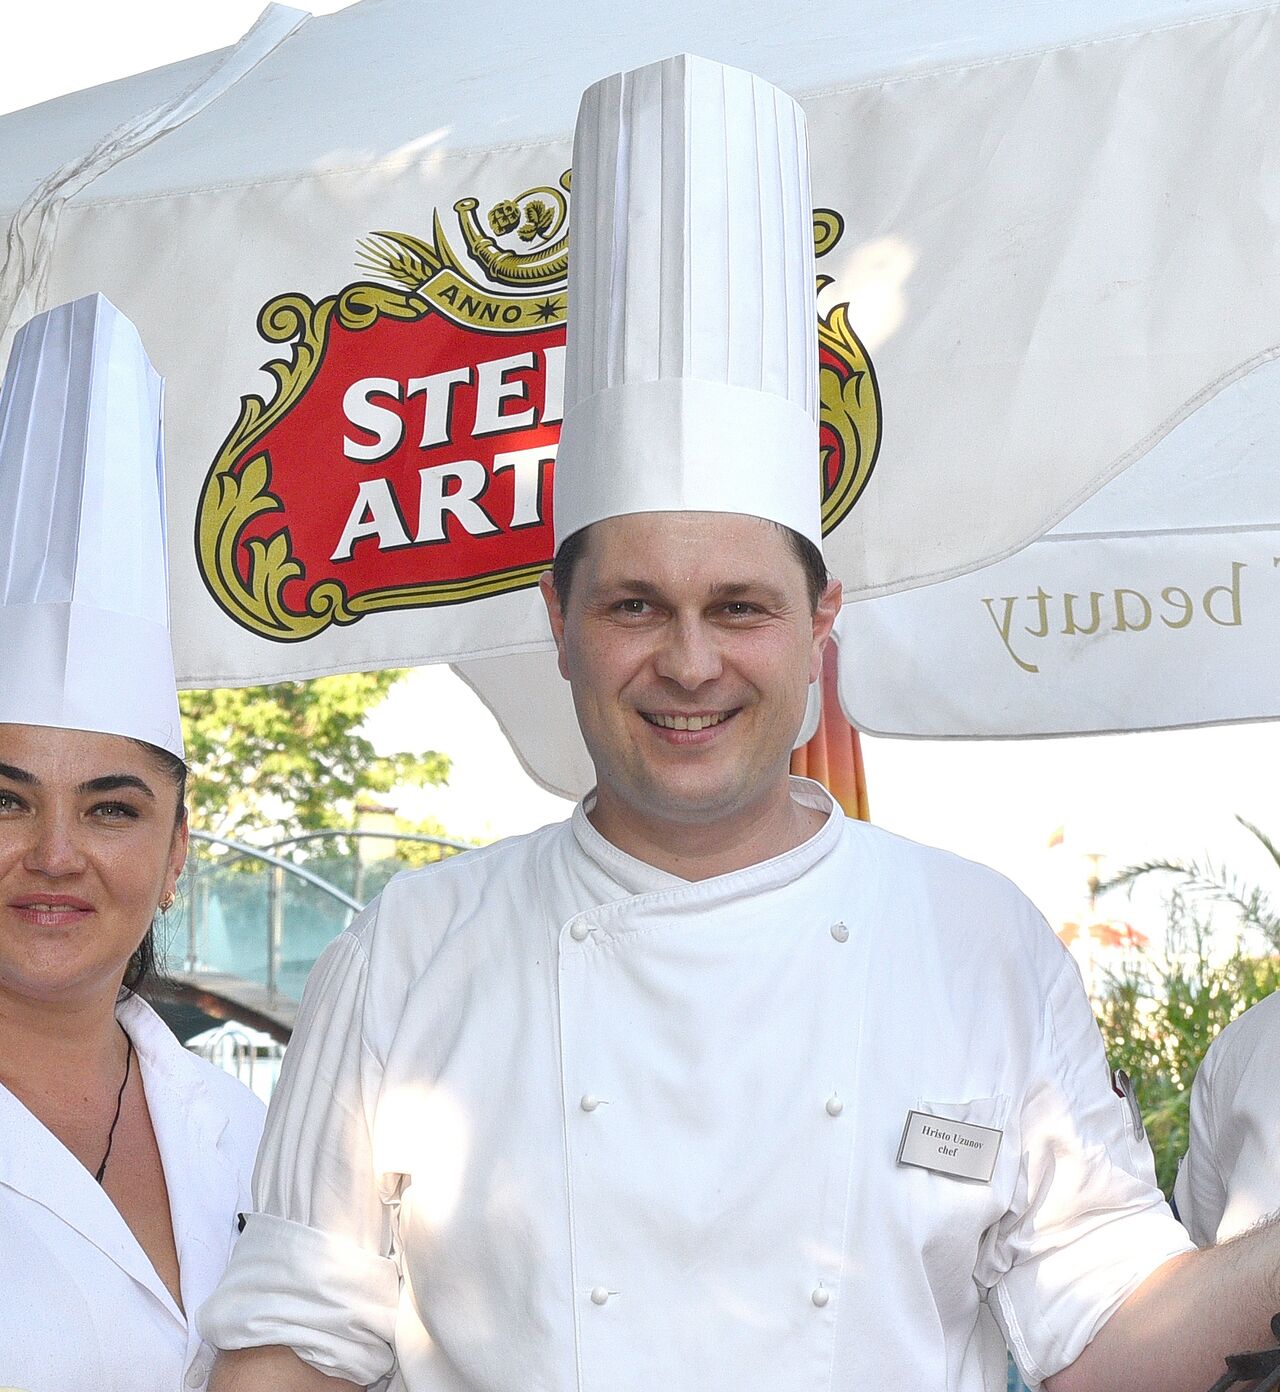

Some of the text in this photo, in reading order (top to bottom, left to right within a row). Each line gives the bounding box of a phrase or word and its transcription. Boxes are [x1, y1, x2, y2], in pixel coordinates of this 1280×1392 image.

[437, 284, 522, 324] ANNO
[921, 1125, 984, 1150] Hristo Uzunov
[938, 1145, 959, 1157] chef
